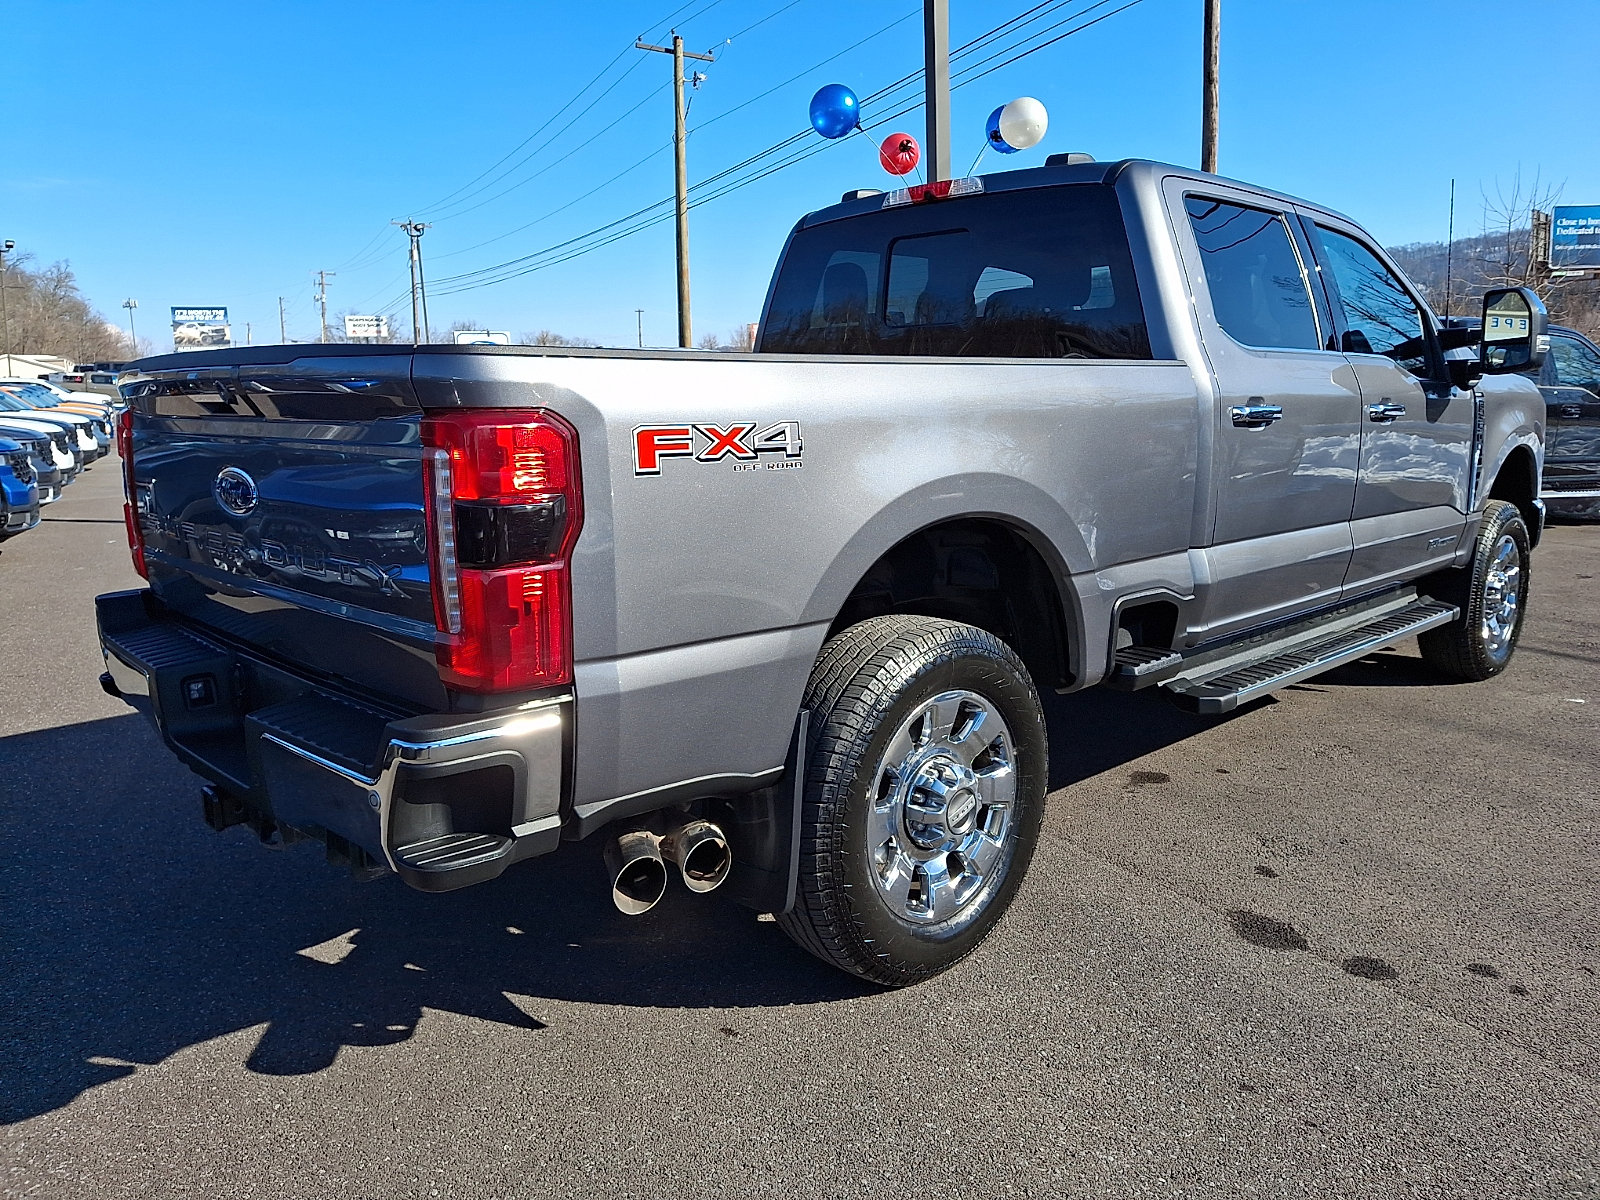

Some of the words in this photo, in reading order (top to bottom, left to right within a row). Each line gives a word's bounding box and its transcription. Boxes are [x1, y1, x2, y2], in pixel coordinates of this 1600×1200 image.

[1556, 217, 1578, 226] Close
[1578, 218, 1587, 226] to
[1556, 226, 1595, 235] Dedicated
[632, 421, 804, 478] FX4
[733, 463, 762, 472] OFF
[767, 461, 803, 471] ROAD
[260, 538, 403, 594] DUTY
